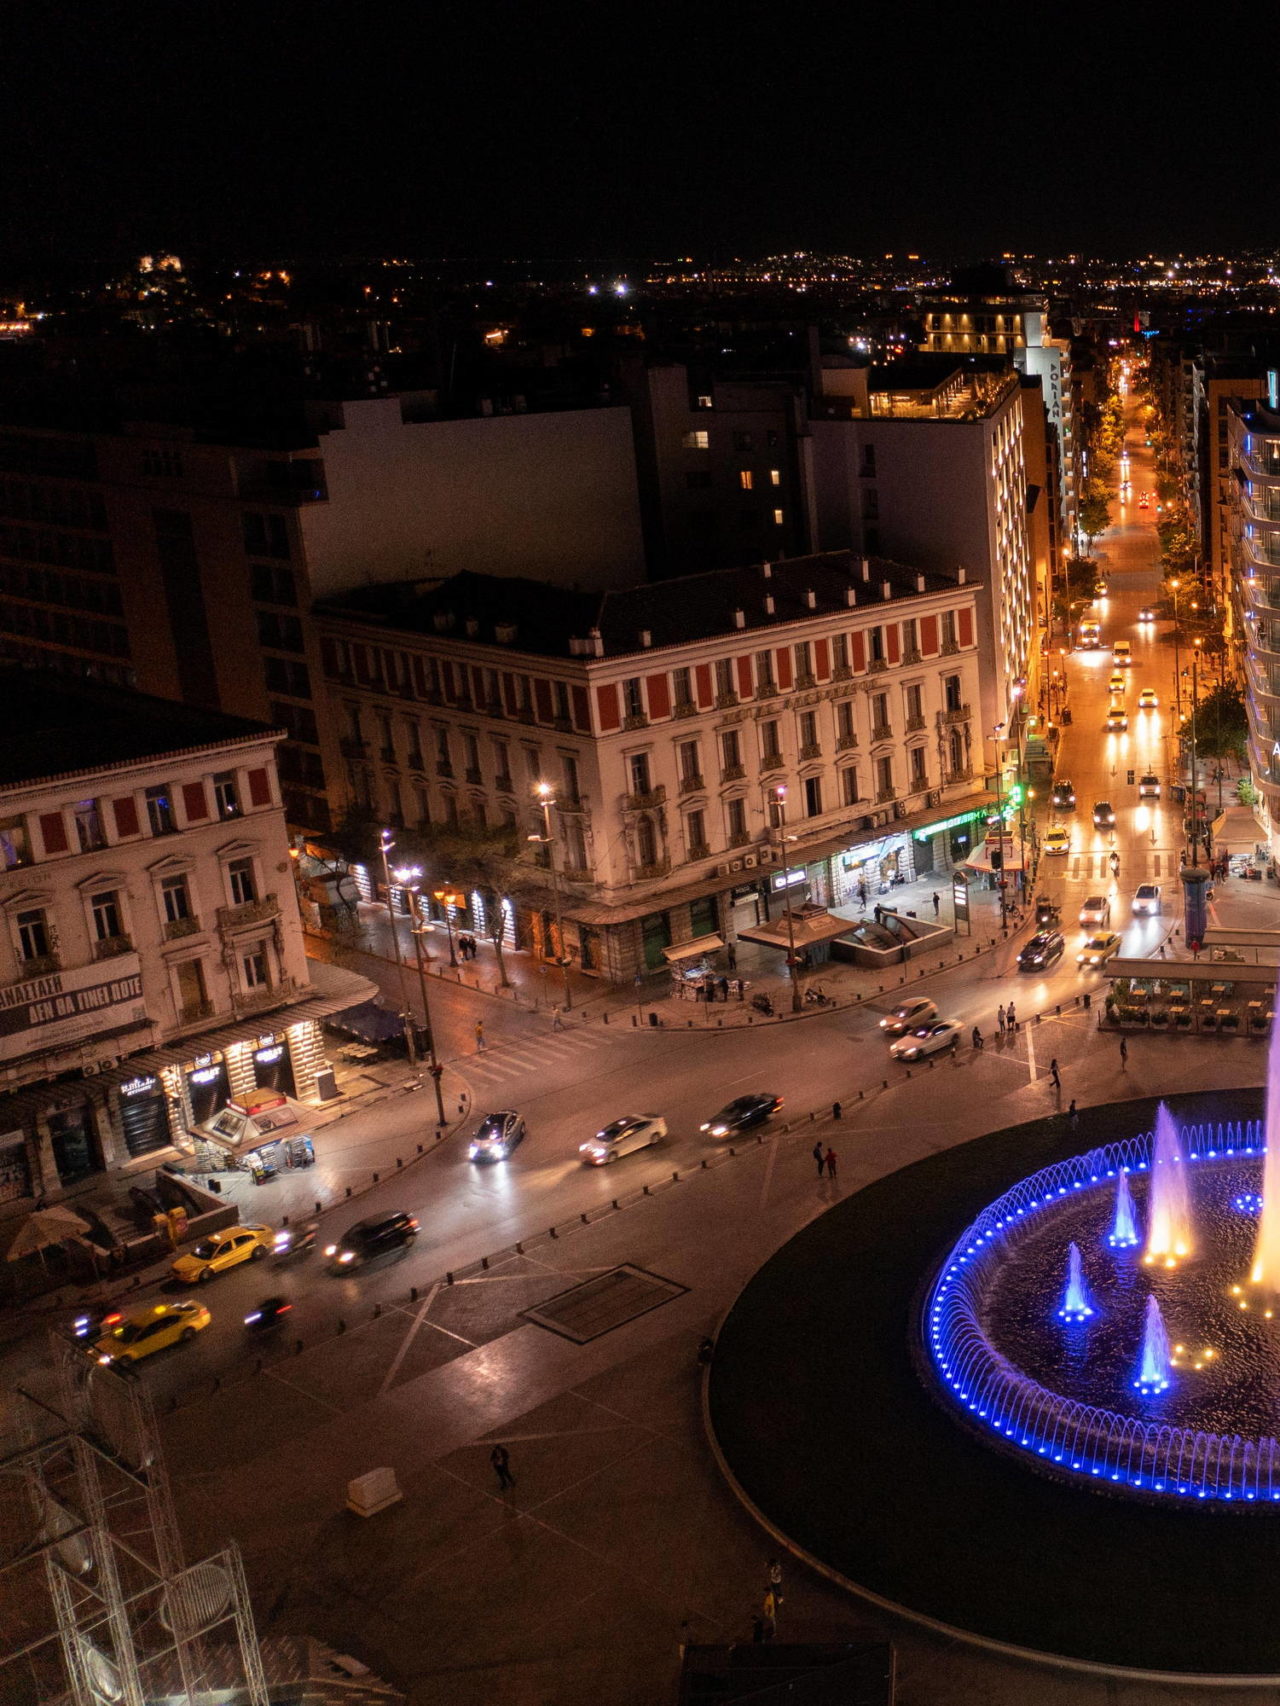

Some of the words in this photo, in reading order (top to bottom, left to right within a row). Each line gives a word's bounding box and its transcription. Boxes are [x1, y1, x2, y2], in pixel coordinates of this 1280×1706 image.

[29, 1001, 54, 1024] ΔΕΝ
[56, 996, 75, 1016] ΘΑ
[77, 986, 110, 1011] ΓΙΝΕΙ
[111, 976, 142, 1000] ΠΟΤΕ
